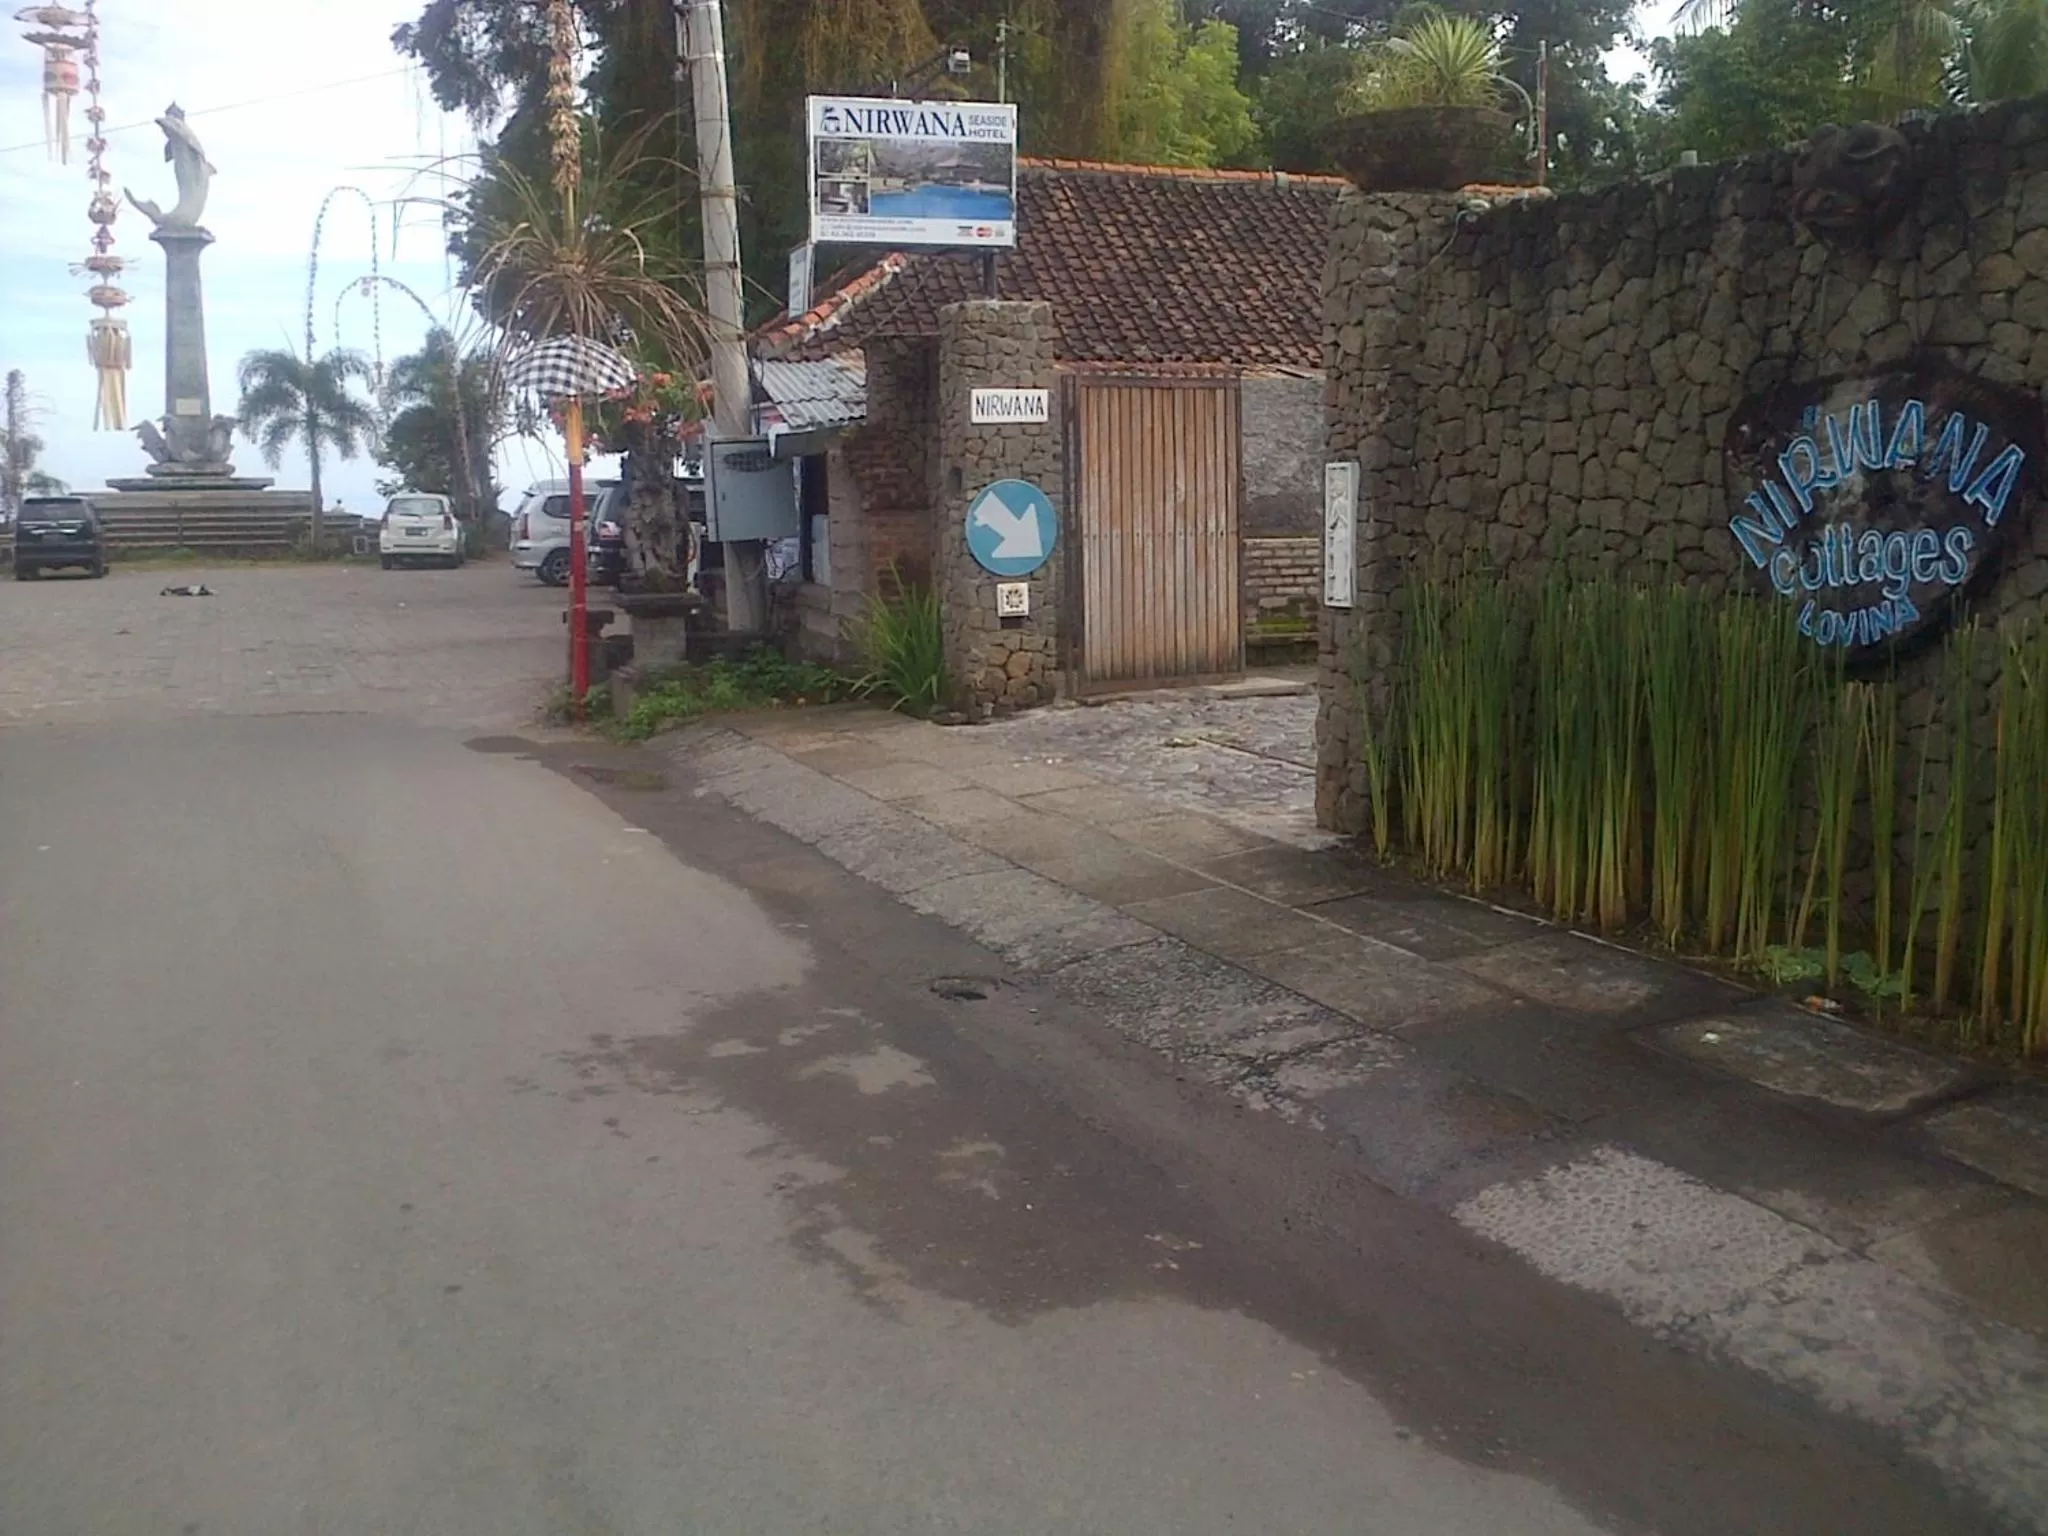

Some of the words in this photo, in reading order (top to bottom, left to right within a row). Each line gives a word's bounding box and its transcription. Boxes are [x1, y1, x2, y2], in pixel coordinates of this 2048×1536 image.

[844, 108, 967, 137] NIRWANA
[969, 115, 1007, 127] SEASIDE
[969, 128, 1007, 139] HOTEL
[975, 394, 1045, 417] NIRWANA
[1729, 399, 2026, 569] NIRWANA
[1797, 596, 1920, 647] LOVINA
